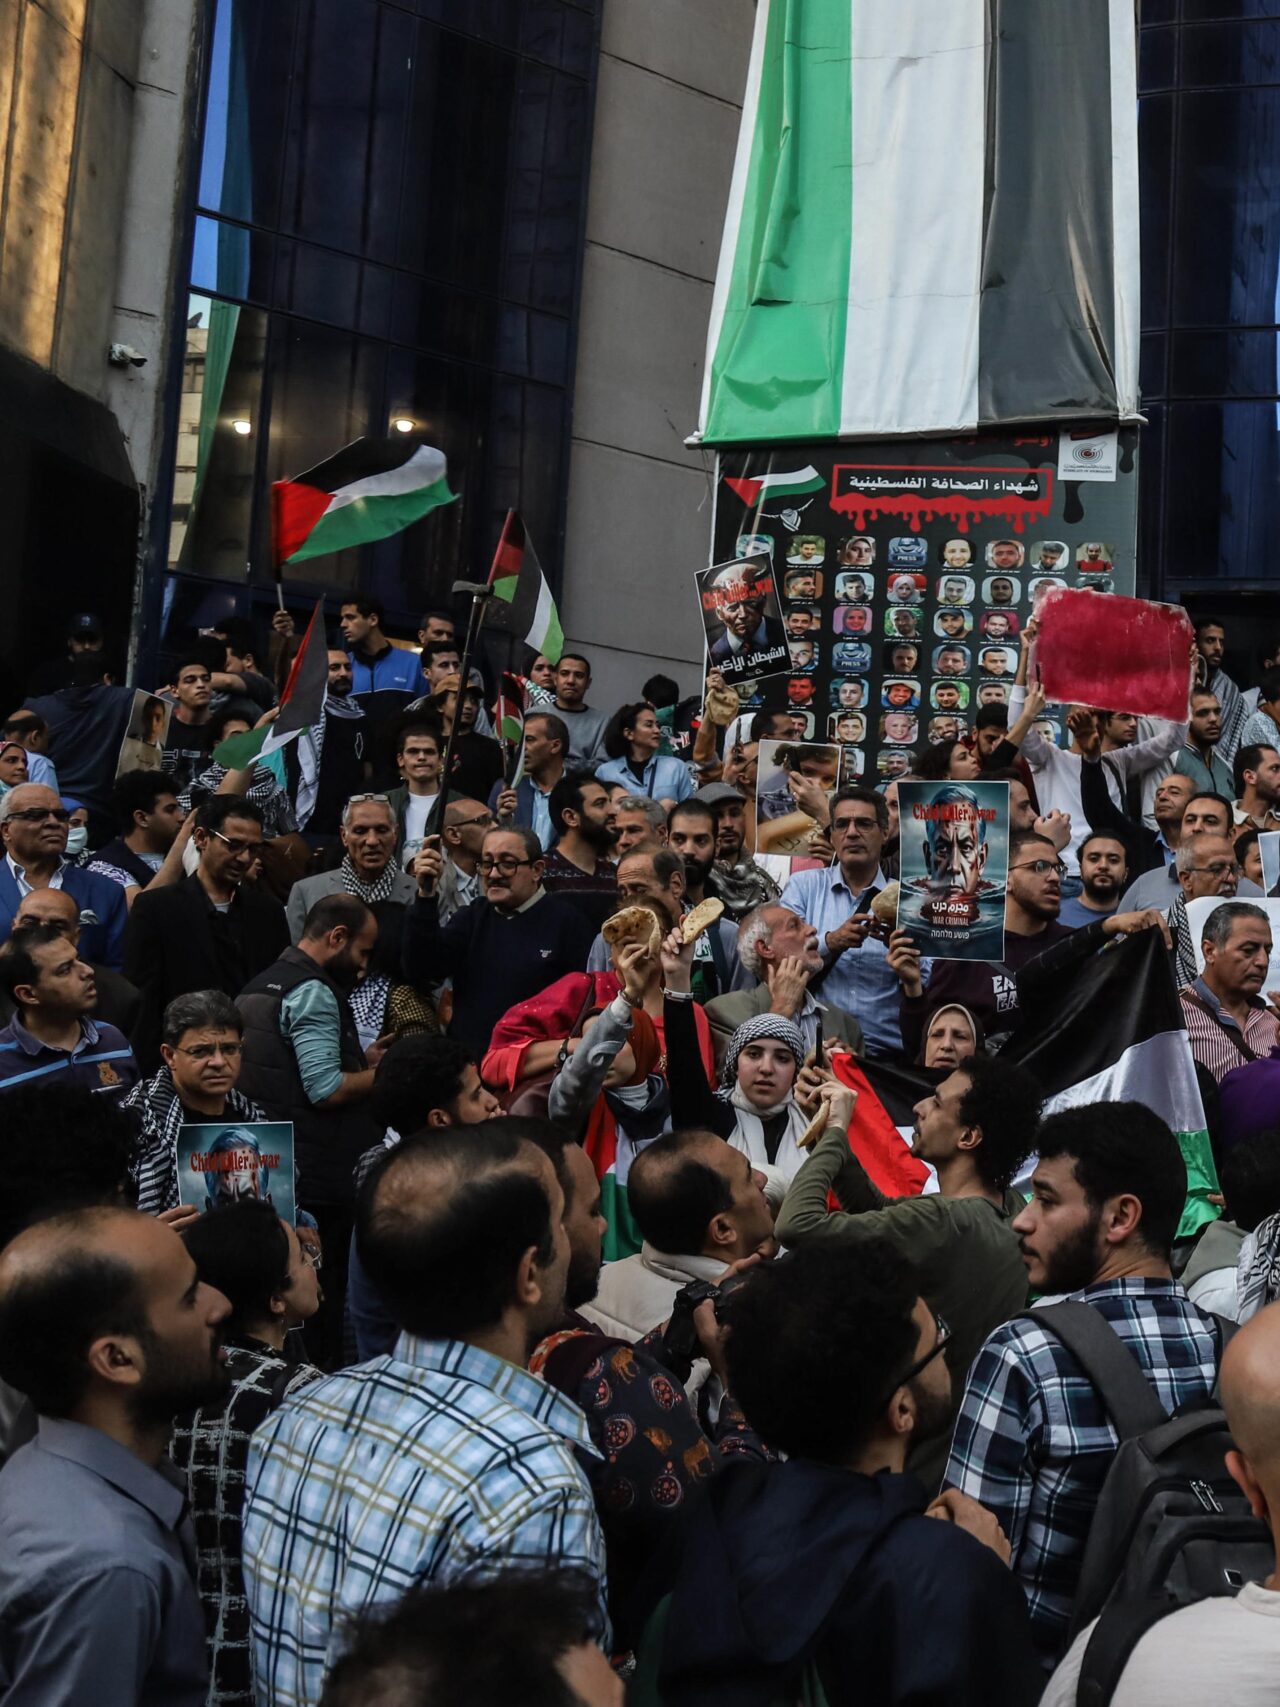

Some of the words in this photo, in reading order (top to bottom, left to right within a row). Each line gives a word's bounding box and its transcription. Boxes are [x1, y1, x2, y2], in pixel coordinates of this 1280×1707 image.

[849, 475, 927, 489] الفلسطينية
[931, 477, 989, 491] الصحافة
[993, 477, 1039, 495] شهداء
[912, 804, 938, 821] Child
[931, 902, 947, 913] حرب
[947, 902, 969, 914] مجرم
[932, 916, 944, 925] WAR
[945, 916, 969, 926] CRIMINAL
[931, 929, 953, 939] מלחמה
[953, 931, 970, 939] פושע
[190, 1151, 218, 1172] Child
